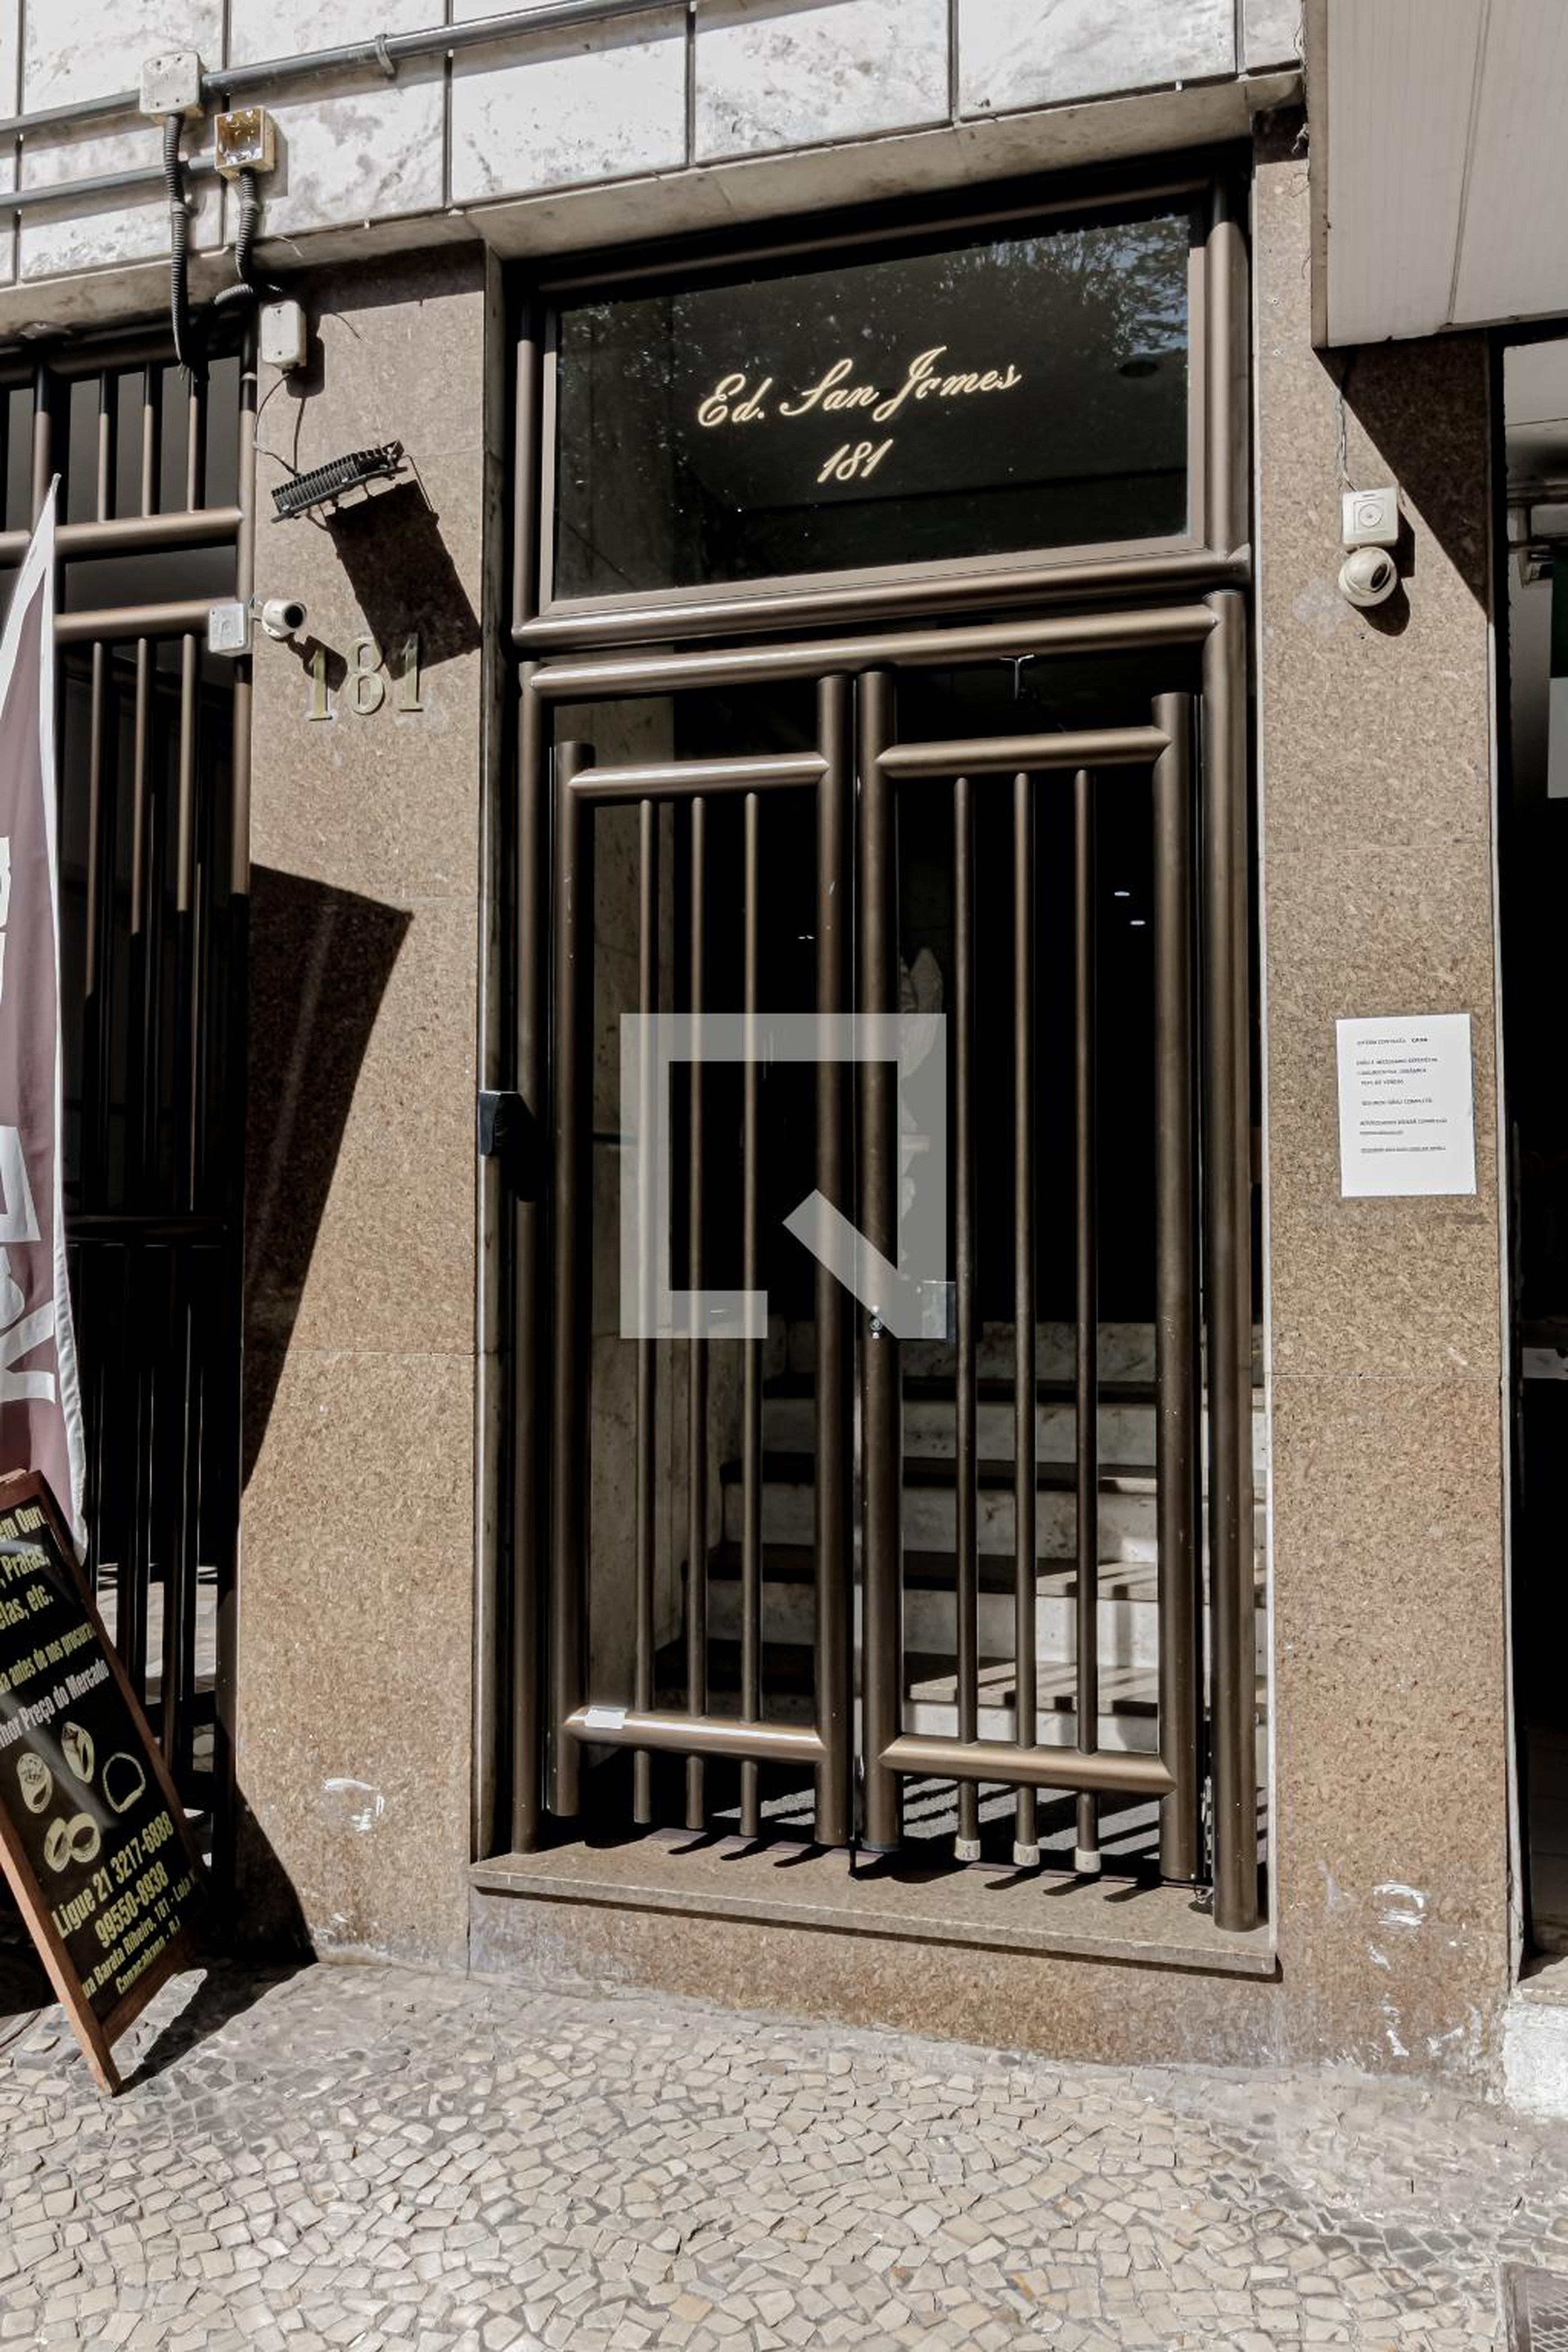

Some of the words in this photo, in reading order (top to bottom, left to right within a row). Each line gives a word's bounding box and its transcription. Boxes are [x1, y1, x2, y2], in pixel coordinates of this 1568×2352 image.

[698, 374, 764, 427] Ed.
[780, 358, 880, 415] San
[817, 439, 893, 482] 181
[305, 633, 423, 720] 181
[26, 1584, 54, 1611] etc.
[18, 1696, 56, 1731] Preço
[53, 1685, 70, 1710] do
[65, 1657, 109, 1700] Mercado
[51, 1887, 96, 1939] Ligue
[92, 1866, 114, 1903] 21
[110, 1811, 174, 1884] 3217-6888
[94, 1861, 169, 1948] 99550-8938
[93, 1947, 126, 1985] Barata
